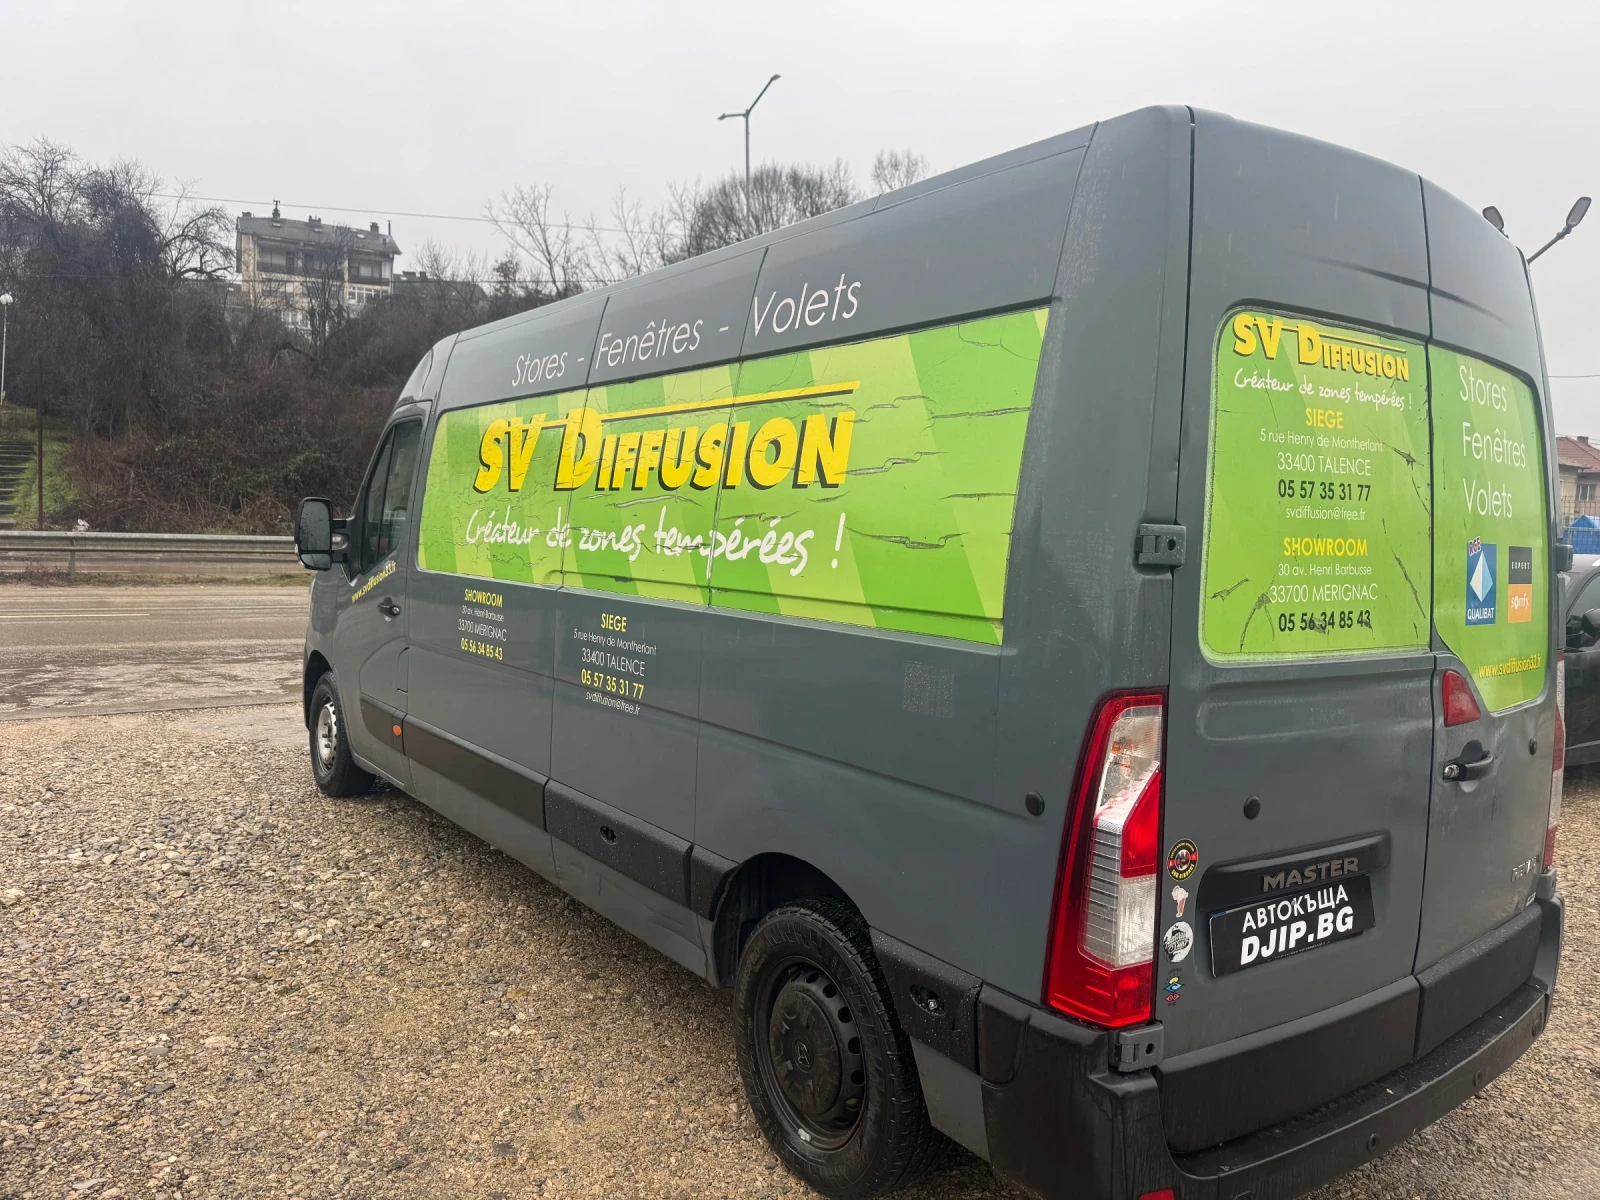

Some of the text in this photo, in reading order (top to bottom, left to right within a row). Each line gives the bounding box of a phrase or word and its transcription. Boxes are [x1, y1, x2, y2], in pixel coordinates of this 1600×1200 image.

[511, 350, 568, 387] Stores
[595, 319, 703, 369] Fenêtres
[753, 273, 862, 337] Volets
[1233, 314, 1409, 381] SV DIFFUSION
[1234, 368, 1294, 391] Créateur
[1299, 375, 1315, 395] de
[1319, 384, 1351, 403] zones
[1355, 382, 1405, 411] tempérées
[1460, 365, 1507, 412] Stores
[1305, 407, 1344, 429] SIEGE
[473, 408, 856, 493] SV DIFFUSION
[1260, 428, 1383, 452] 5 rue Henry de Montherlant
[1462, 421, 1526, 468] Fenêtres
[1277, 452, 1372, 476] 33400 TALENCE
[1278, 479, 1371, 502] 05 57 35 31 77
[1463, 478, 1513, 518] Volets
[1285, 506, 1366, 521] svdiffusion@free.fr
[465, 505, 846, 581] Créateur de zones tempérées !
[1283, 537, 1368, 556] SHOWROOM
[1469, 537, 1481, 556] RGE
[1278, 563, 1372, 576] 30 av. Henri Barbusse
[464, 589, 502, 607] SHOWROOM
[1270, 583, 1378, 604] 33700 MERIGNAC
[1511, 593, 1529, 609] somfy
[462, 605, 467, 614] 30
[474, 607, 486, 619] Henri
[600, 613, 627, 632] SIEGE
[1278, 609, 1371, 632] 05 56 34 85 43
[1467, 607, 1495, 620] QUALIBAT
[458, 618, 507, 642] 33700 MERIGNAC
[573, 628, 657, 655] 5 rue Henry de Montherlant
[460, 637, 503, 660] 05 56 34 85 43
[581, 648, 645, 677] 33400 TALENCE
[1478, 654, 1541, 679] www.svdiffusion33.fr
[581, 668, 644, 700] 05 57 35 31 77
[586, 691, 641, 716] svdiffusion@free.fr
[1263, 857, 1359, 892] MASTER
[1242, 884, 1349, 934] АВТОКЪЩА
[1240, 906, 1354, 966] DJIP.BG
